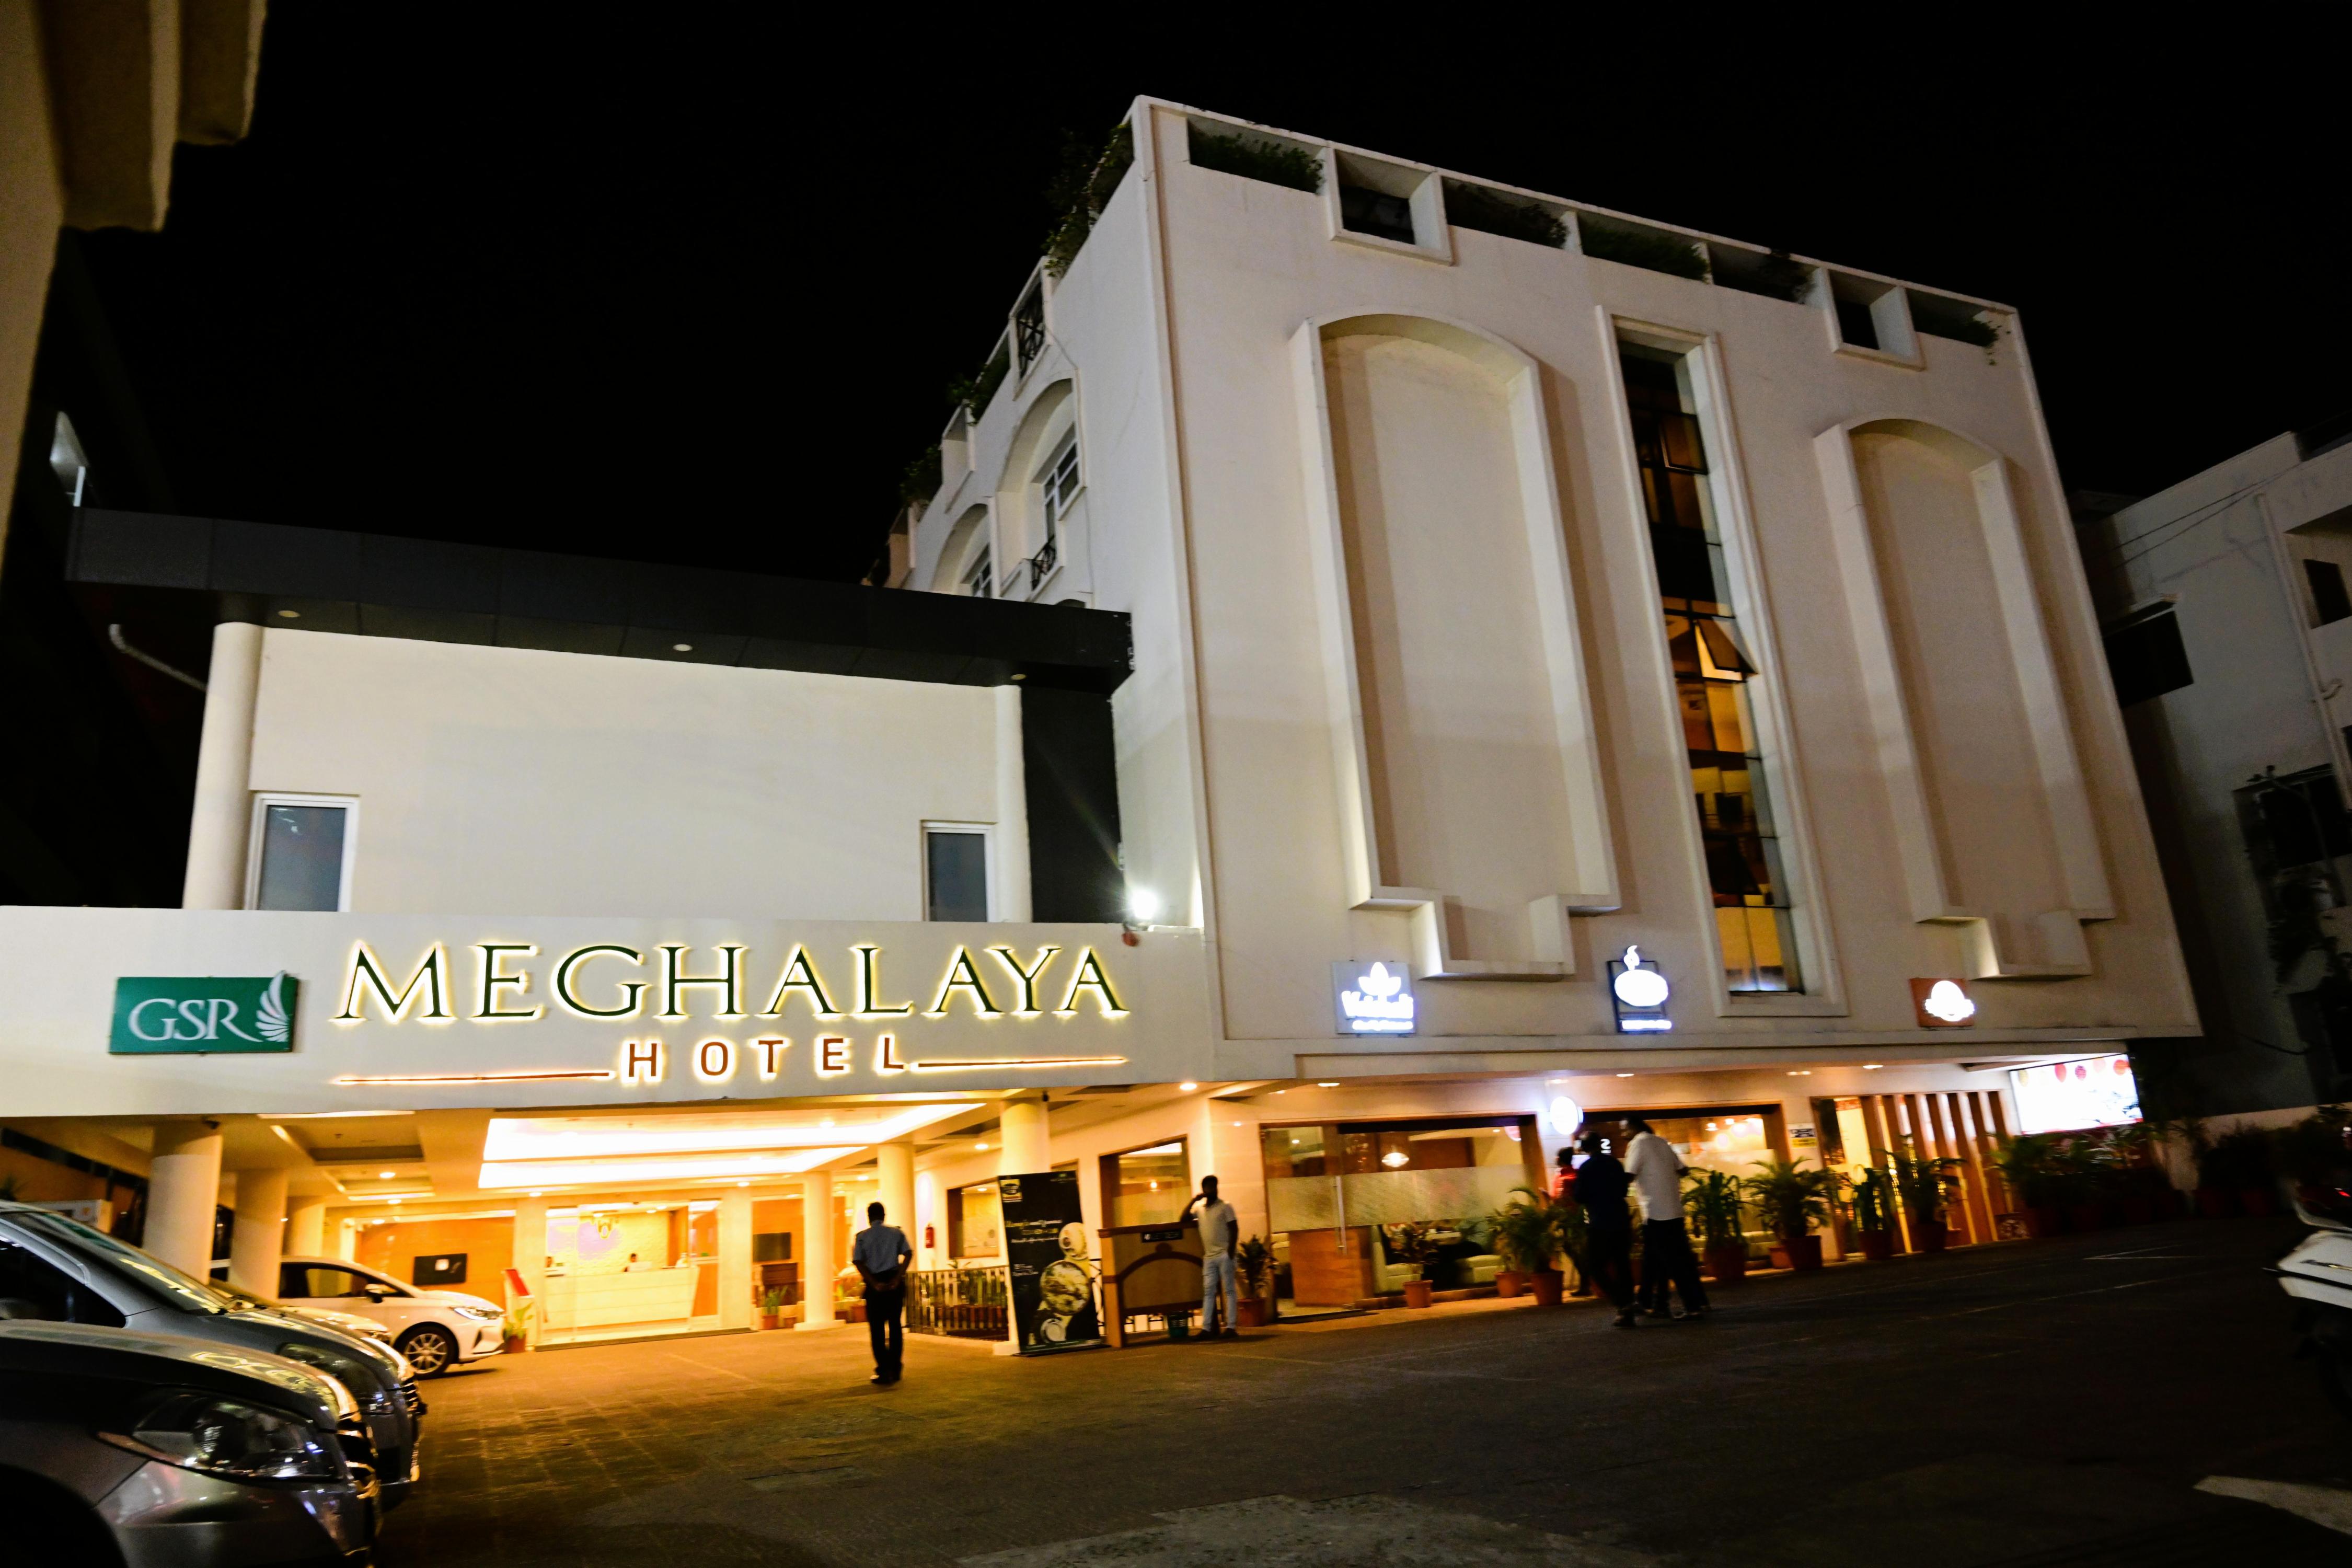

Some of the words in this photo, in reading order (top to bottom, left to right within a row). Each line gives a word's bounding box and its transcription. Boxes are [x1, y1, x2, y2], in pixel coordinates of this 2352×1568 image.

[332, 942, 1129, 1022] MEGHALAYA
[128, 997, 263, 1042] GSR
[624, 1035, 907, 1081] HOTEL
